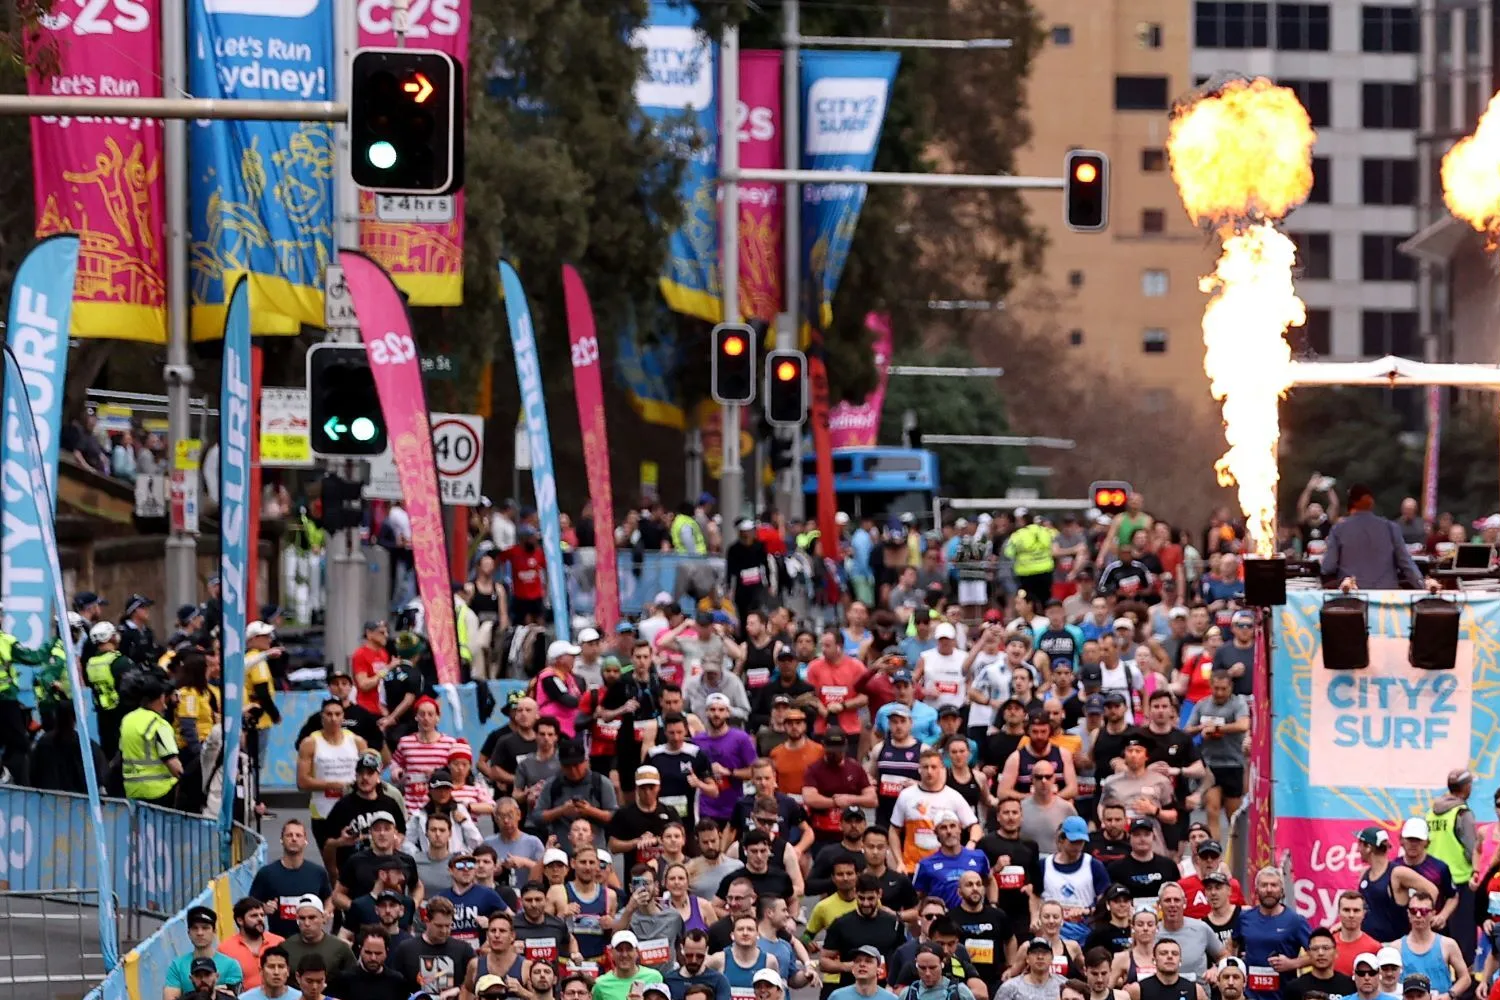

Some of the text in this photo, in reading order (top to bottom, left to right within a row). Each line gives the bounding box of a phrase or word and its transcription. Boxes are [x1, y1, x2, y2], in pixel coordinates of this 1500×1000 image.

[216, 36, 311, 61] Let's Run
[52, 74, 140, 96] Let's Run
[218, 61, 326, 98] ydney!
[329, 306, 356, 319] LAN
[434, 435, 472, 460] 40
[441, 480, 476, 498] REA
[1327, 674, 1459, 714] CITY2
[1332, 715, 1450, 750] SURF
[1311, 840, 1366, 872] Let
[1253, 976, 1274, 986] 3152
